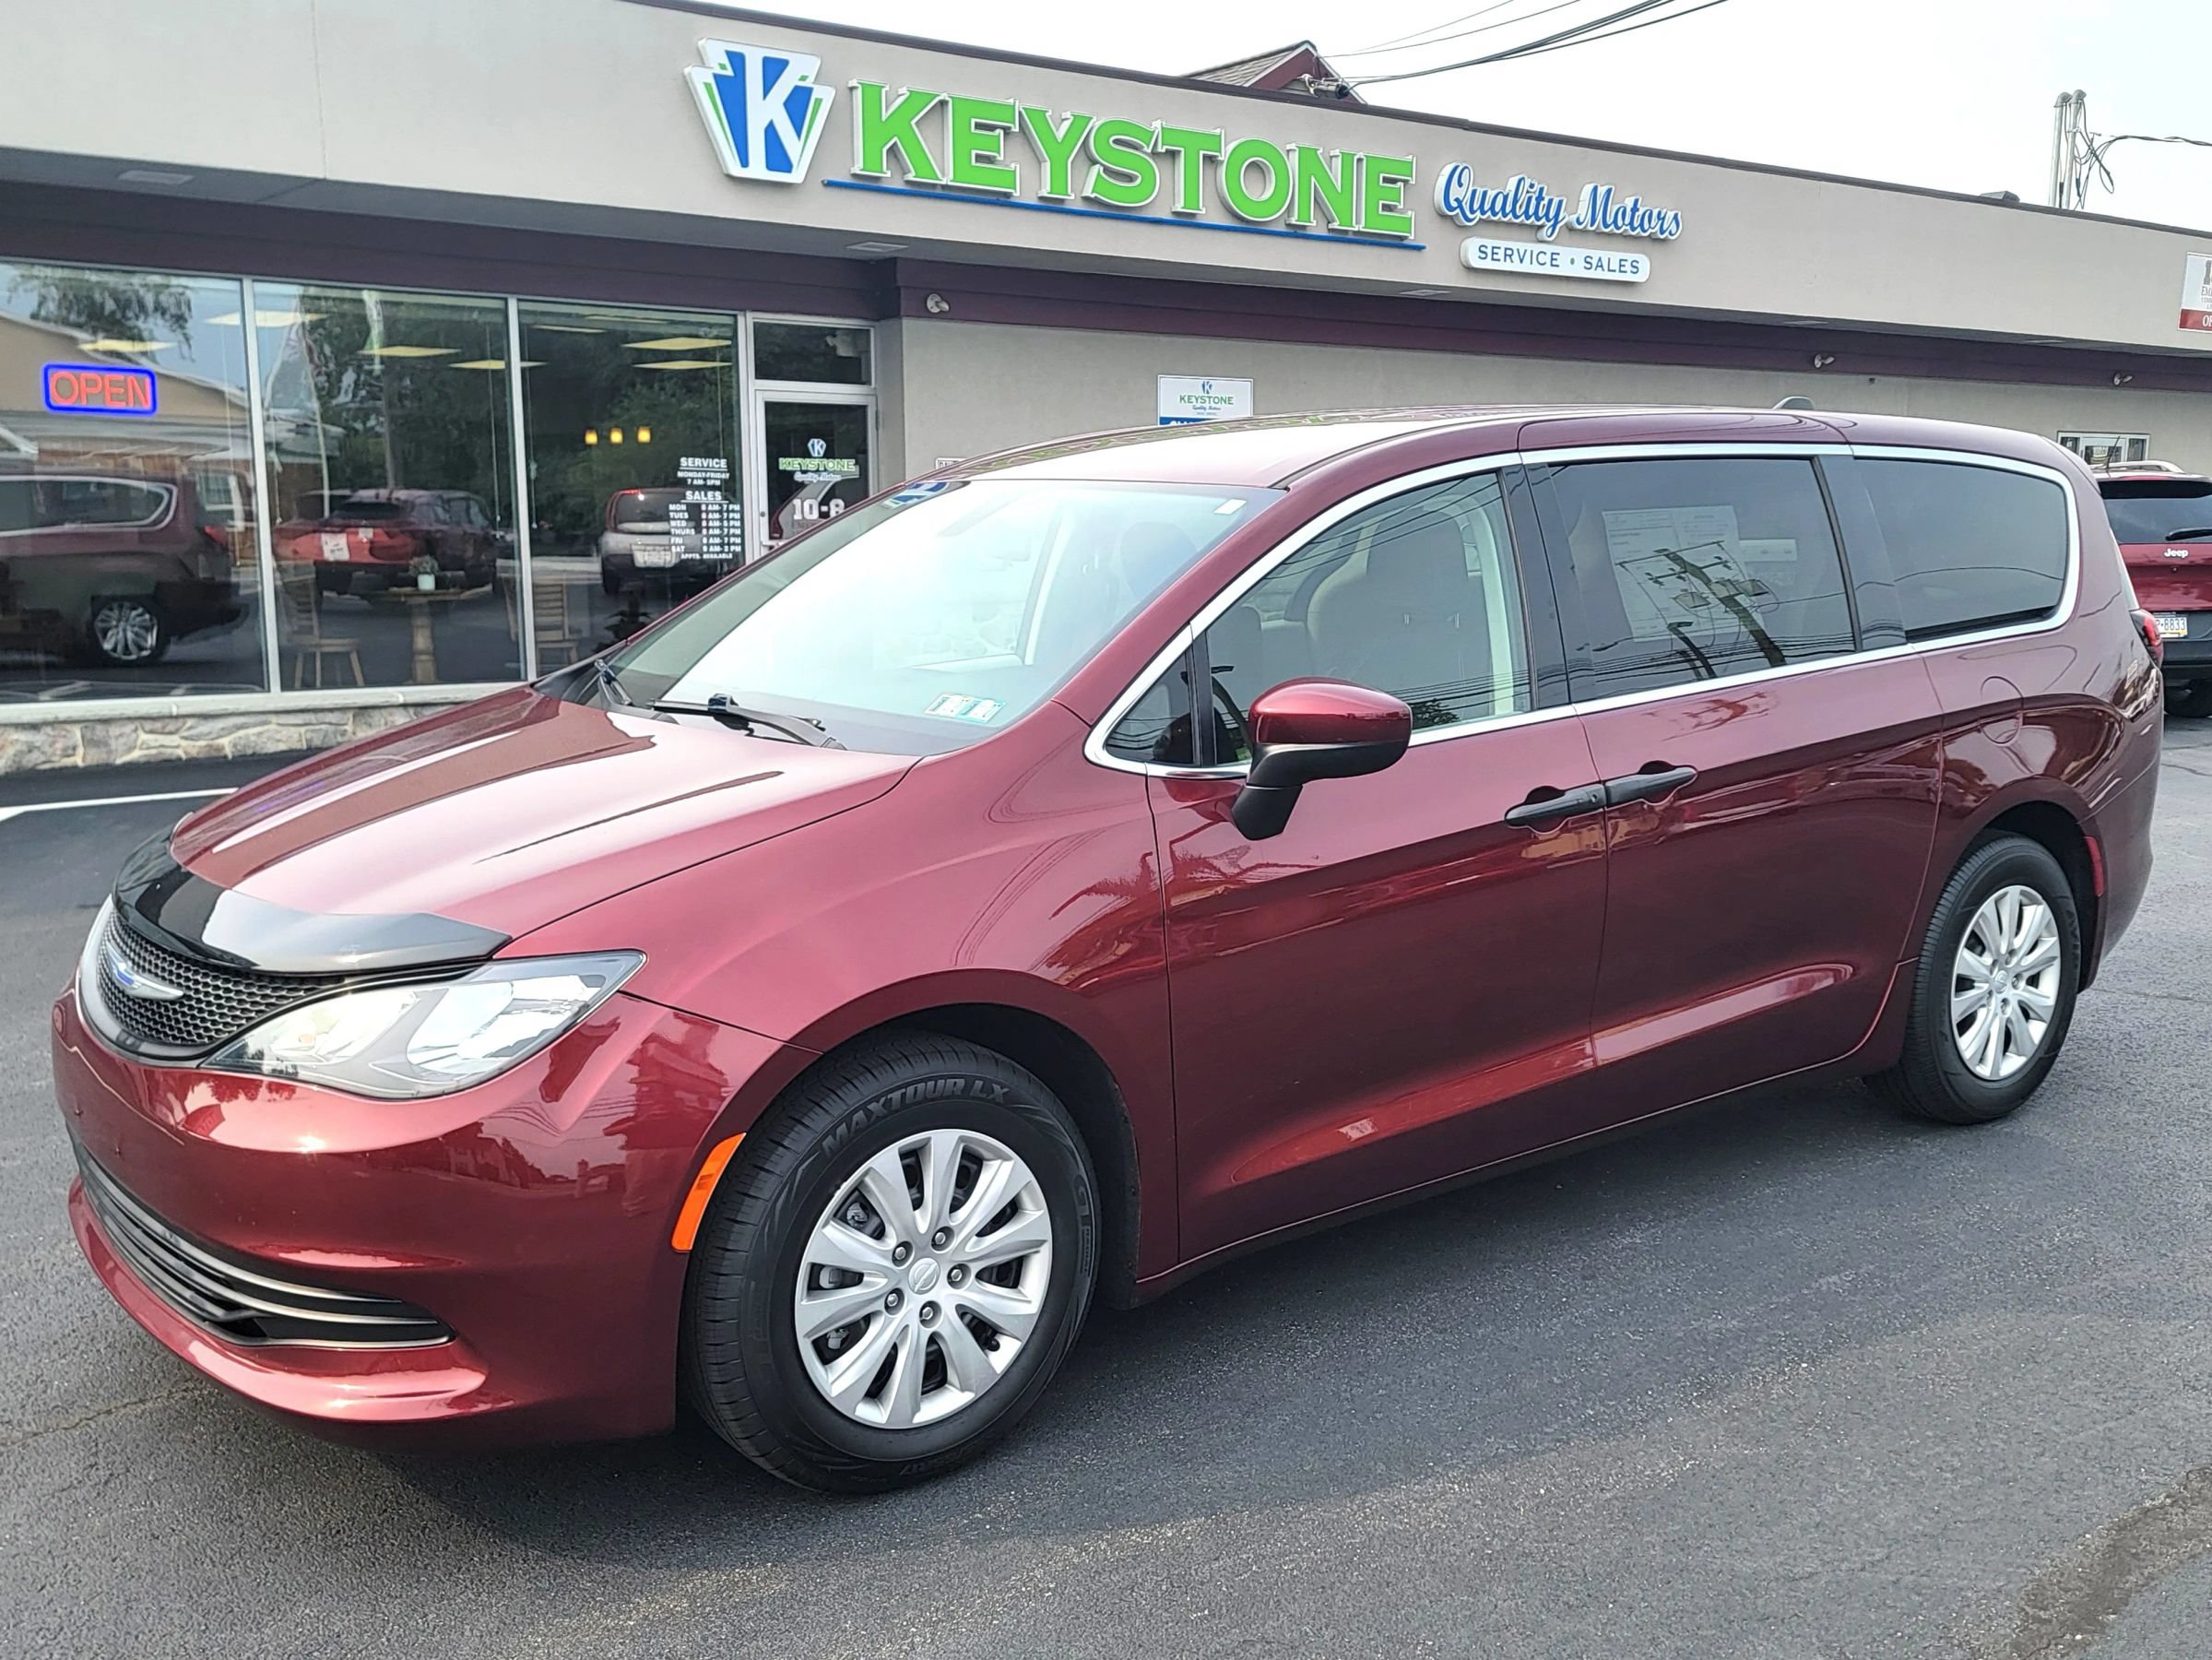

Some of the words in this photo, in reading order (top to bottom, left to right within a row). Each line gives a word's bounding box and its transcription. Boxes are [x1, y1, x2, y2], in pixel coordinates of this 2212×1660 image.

[848, 77, 1417, 240] KEYSTONE
[1438, 163, 1567, 240] Quality
[1573, 184, 1681, 239] Motors
[1477, 244, 1561, 267] SERVICE
[1583, 255, 1640, 275] SALES
[50, 371, 151, 409] OPEN
[1179, 394, 1235, 405] KEYSTONE
[680, 456, 727, 468] SERVICE
[778, 457, 856, 471] KEYSTONE
[685, 491, 722, 501] SALES
[2163, 548, 2189, 558] Jeep
[822, 1078, 966, 1154] MAXTOUR
[970, 1080, 1011, 1104] LX
